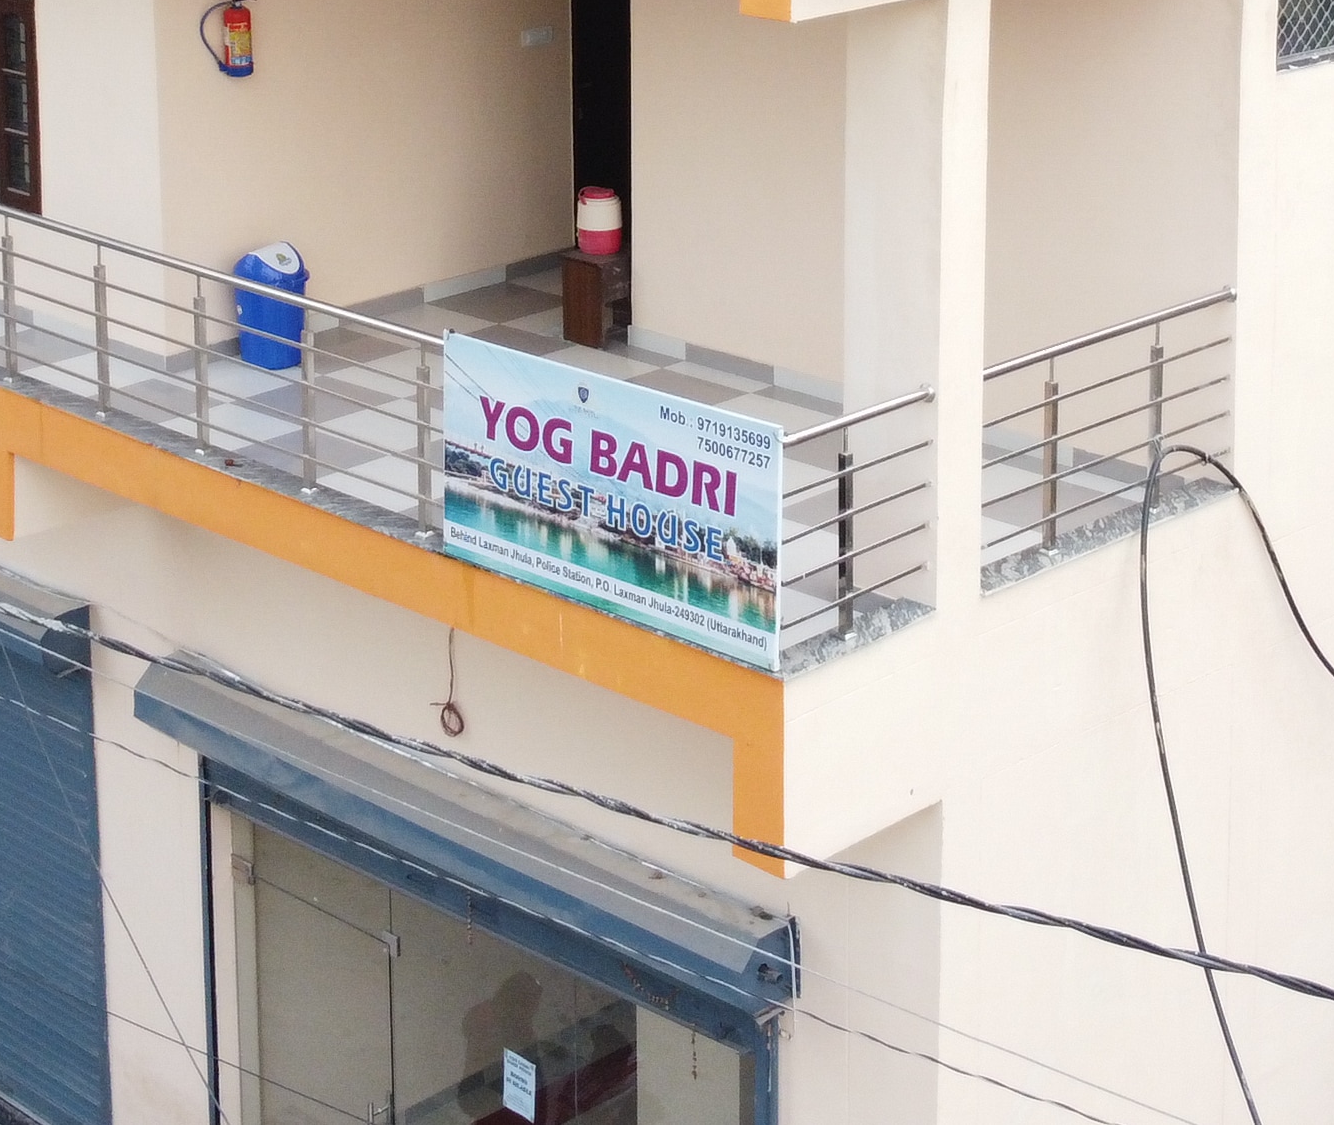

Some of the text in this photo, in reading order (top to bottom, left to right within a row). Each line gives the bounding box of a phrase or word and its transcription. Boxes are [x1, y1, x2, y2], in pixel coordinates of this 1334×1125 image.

[479, 396, 738, 517] YOG BADRI
[697, 417, 771, 450] 9719135699
[697, 436, 771, 469] 7500677257
[490, 457, 724, 561] GUEST HOUSE
[450, 526, 477, 545] Behind
[478, 537, 510, 557] Laxman
[510, 548, 535, 568] Jhula,
[535, 556, 561, 575] Police
[562, 565, 594, 588] Station,
[613, 584, 647, 606] Laxman
[648, 596, 705, 627] Jhula-249302
[706, 617, 768, 652] (Uttarakhand)
